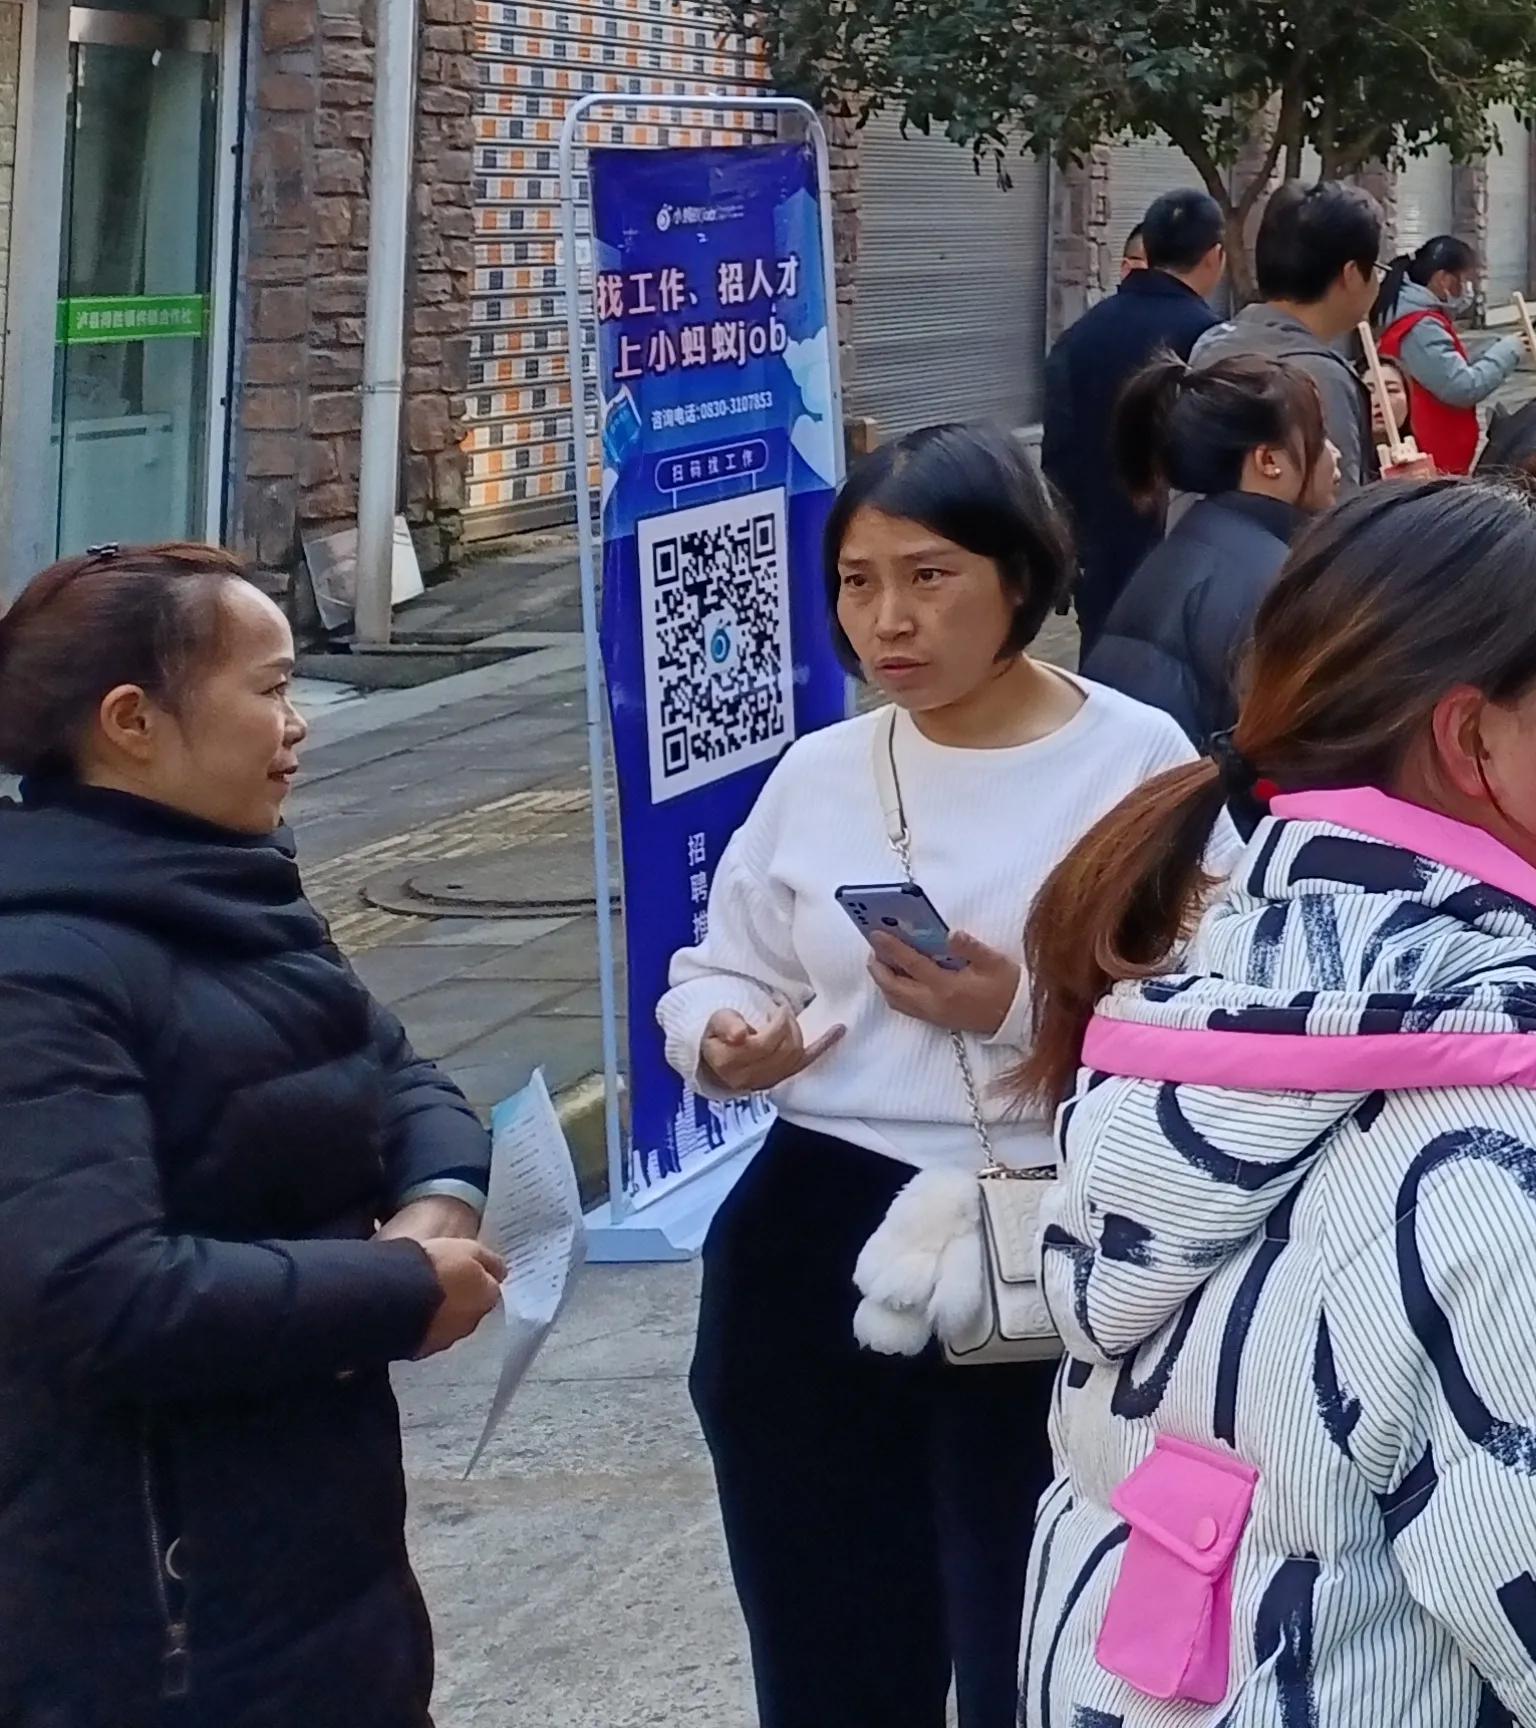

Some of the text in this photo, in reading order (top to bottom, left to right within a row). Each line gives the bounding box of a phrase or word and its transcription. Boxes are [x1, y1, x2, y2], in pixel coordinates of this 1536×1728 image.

[597, 254, 800, 320] 找工作、招人才
[613, 314, 788, 380] 上小蚂蚁job
